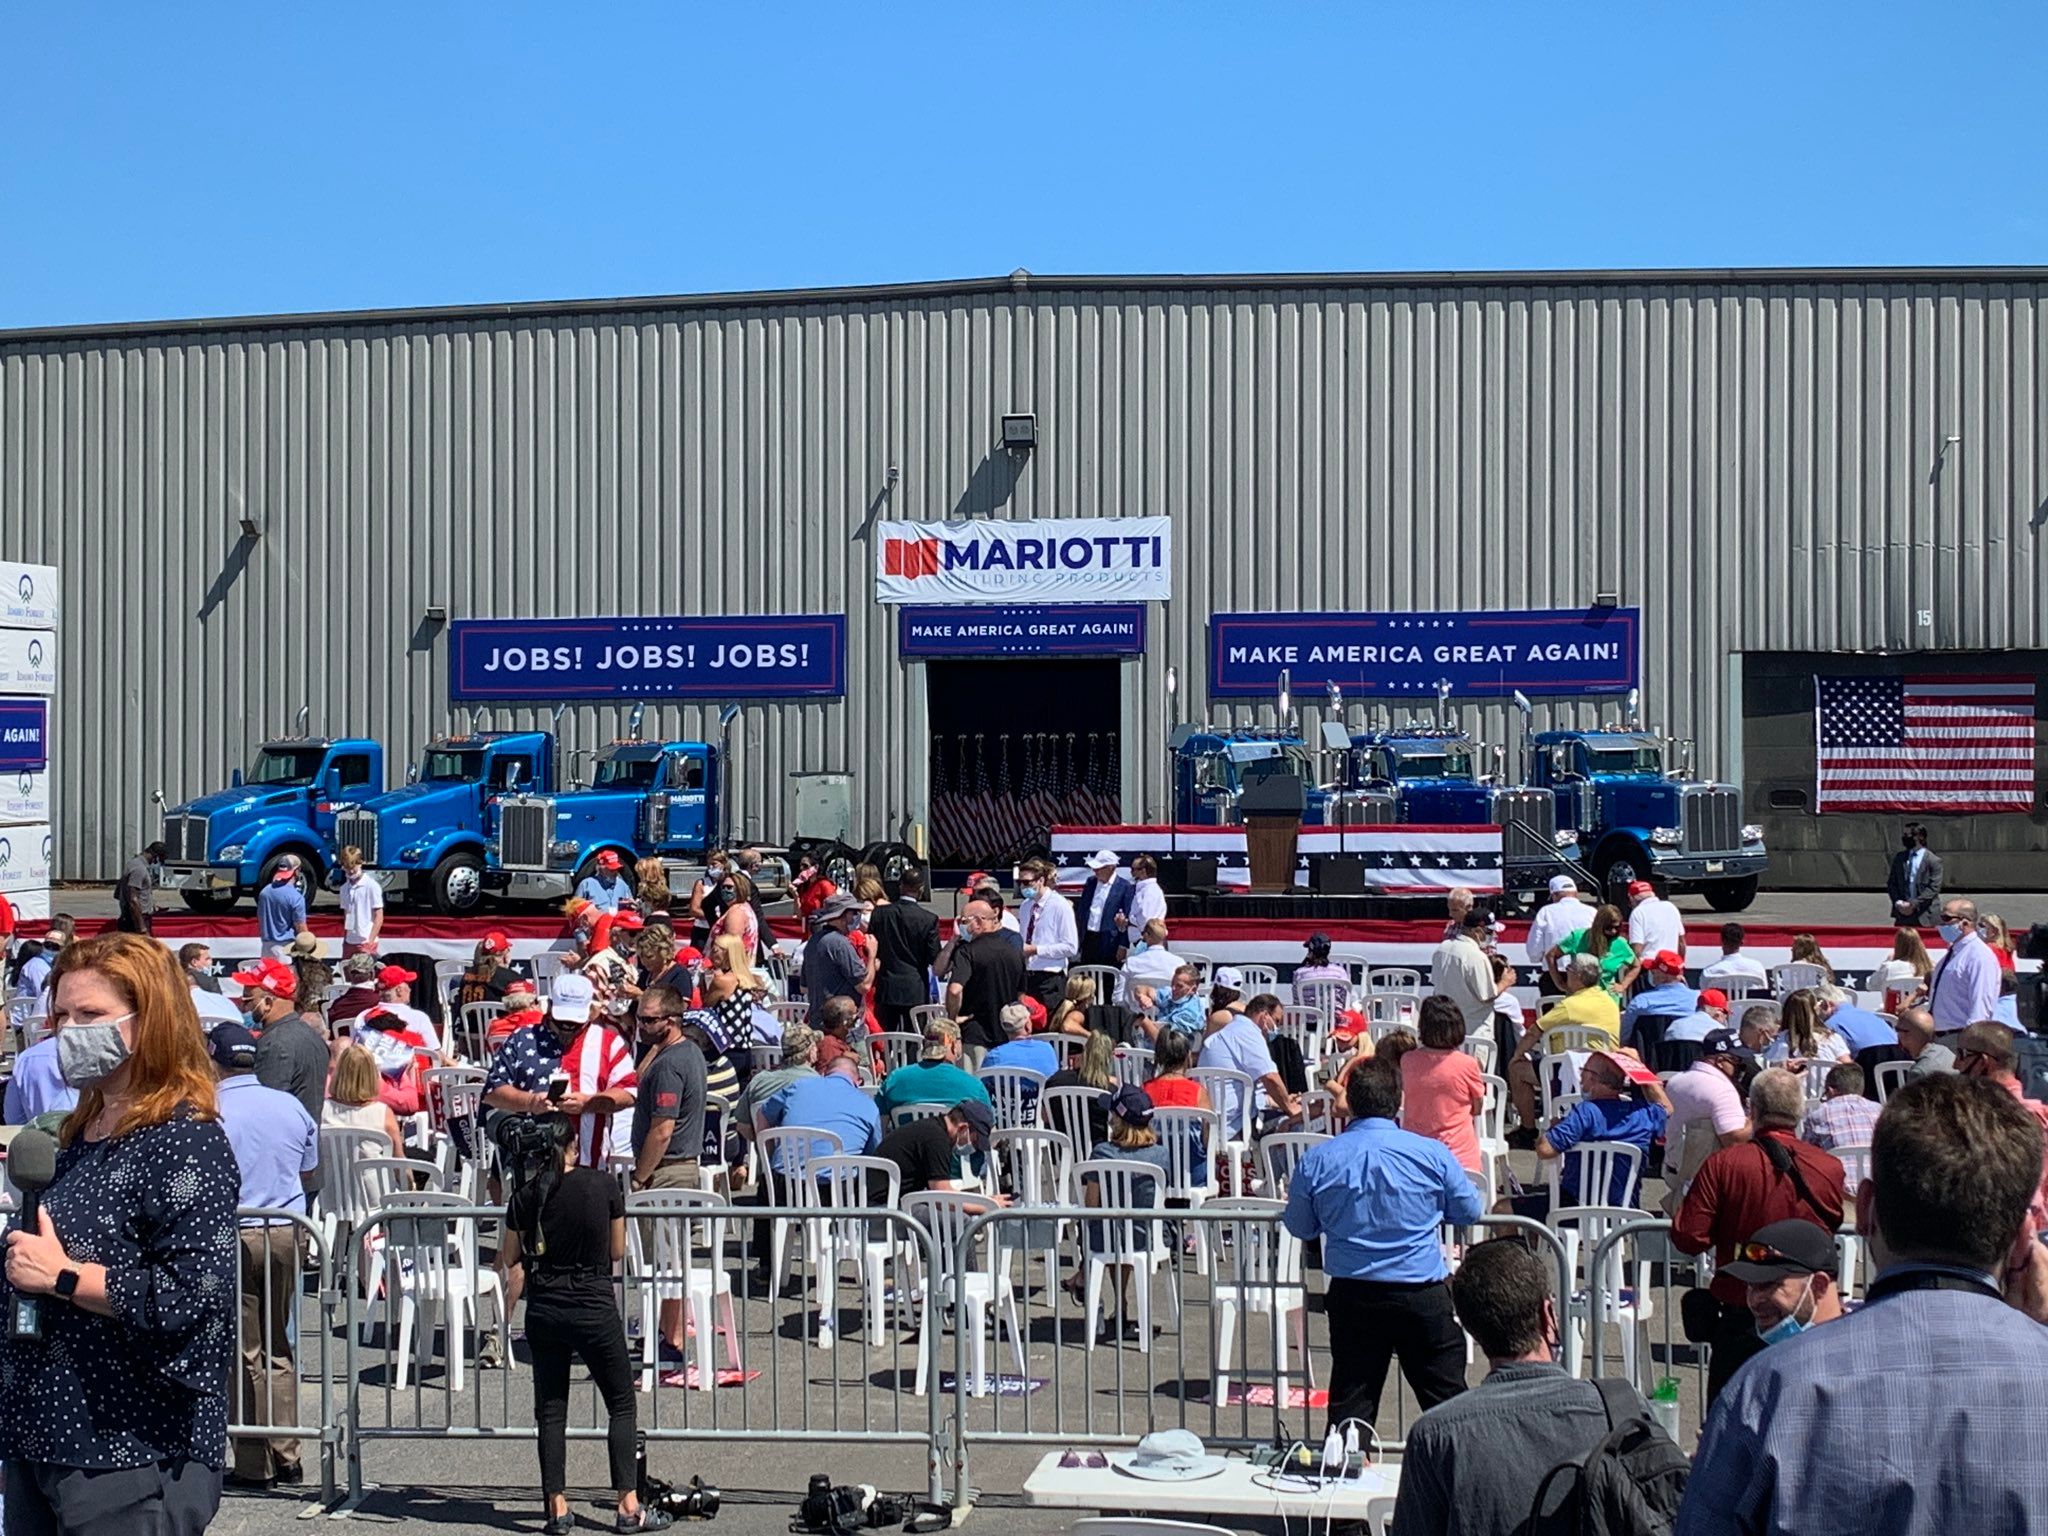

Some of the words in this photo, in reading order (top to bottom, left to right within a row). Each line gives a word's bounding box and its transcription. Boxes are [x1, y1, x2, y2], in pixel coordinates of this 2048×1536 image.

[945, 535, 1162, 571] MARIOTTI
[1056, 571, 1164, 584] PRODUCTS
[1917, 610, 1932, 626] 15
[912, 625, 952, 637] MAKE
[957, 625, 1023, 636] AMERICA
[1029, 624, 1076, 635] GREAT
[1082, 623, 1134, 635] AGAIN!
[484, 647, 582, 672] JOBS!
[596, 645, 695, 669] JOBS!
[709, 644, 809, 669] JOBS!
[1229, 646, 1299, 663] MAKE
[1308, 645, 1424, 663] AMERICA
[1434, 644, 1517, 662] GREAT
[1527, 643, 1620, 661] AGAIN!
[3, 728, 40, 742] AGAIN!
[670, 794, 705, 804] MARIOTTI
